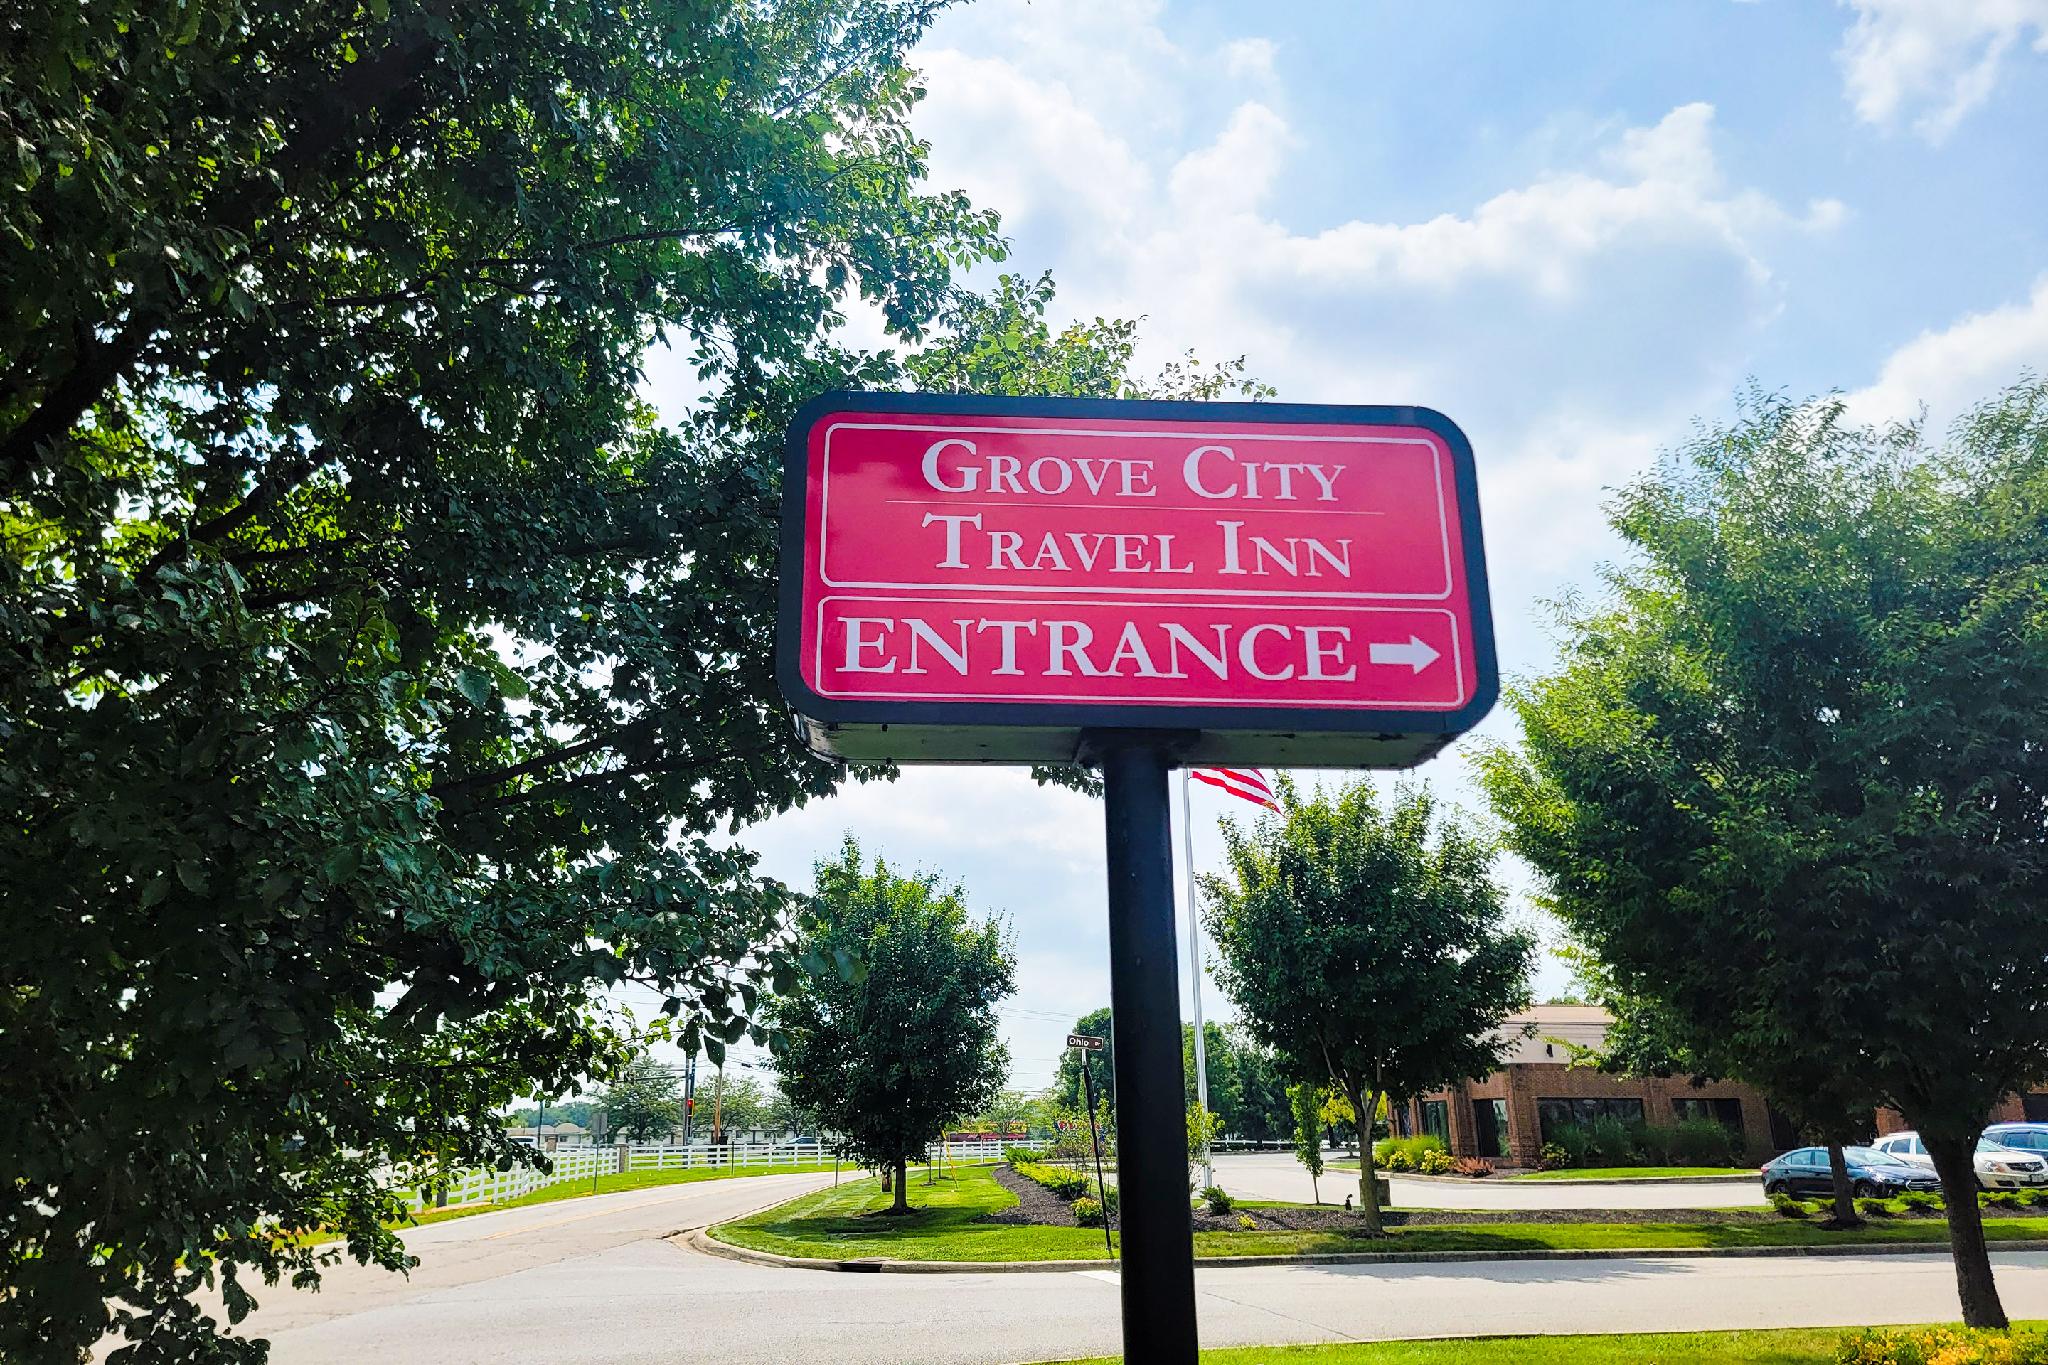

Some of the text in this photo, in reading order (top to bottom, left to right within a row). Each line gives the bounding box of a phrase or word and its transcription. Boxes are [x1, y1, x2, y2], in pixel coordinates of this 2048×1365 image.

[922, 439, 1346, 502] GROVE CITY
[922, 511, 1353, 578] TRAVEL INN
[835, 616, 1357, 682] ENTRANCE
[1069, 1037, 1089, 1047] Ohio
